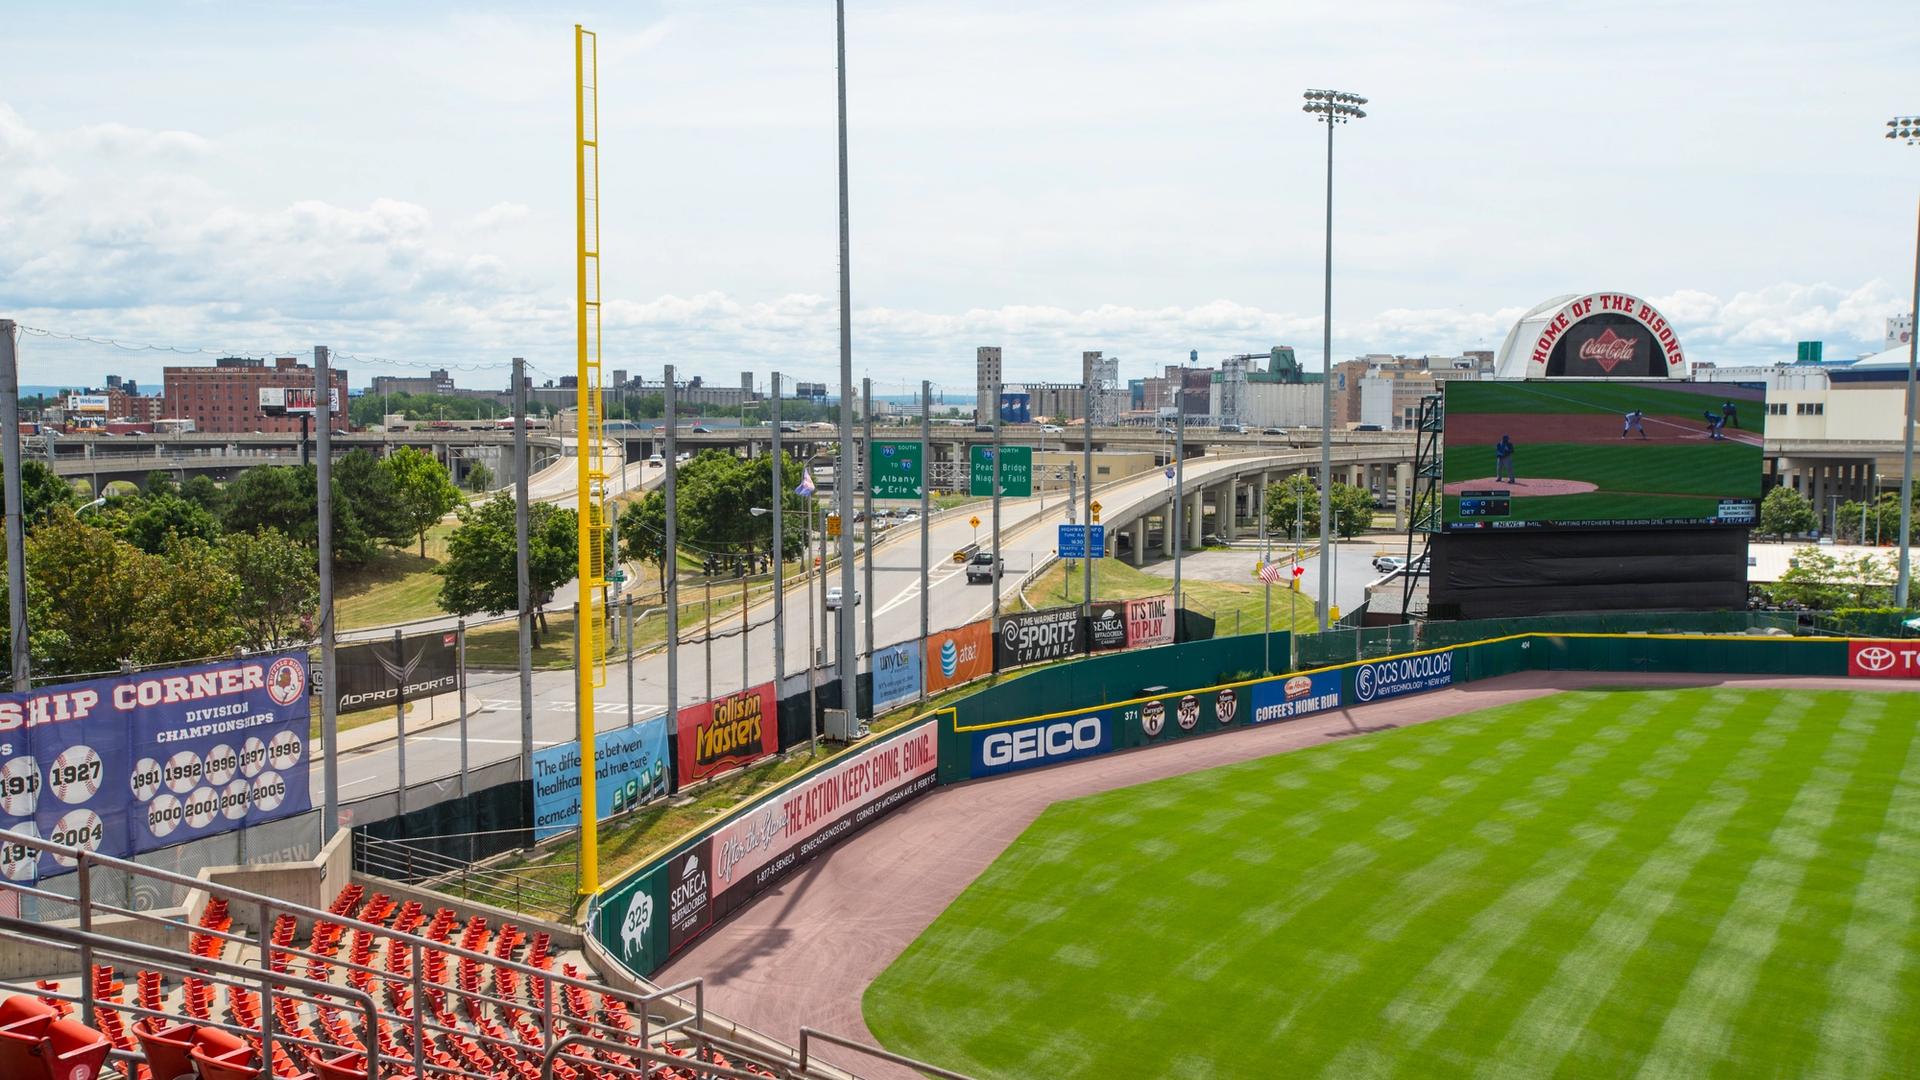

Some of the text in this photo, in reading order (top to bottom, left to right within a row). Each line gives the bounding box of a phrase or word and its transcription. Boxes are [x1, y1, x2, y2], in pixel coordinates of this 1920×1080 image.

[1533, 295, 1683, 365] HOME OF THE BISONS
[881, 475, 916, 484] Albany
[1002, 463, 1027, 473] Bridge
[1008, 474, 1026, 483] Falls
[1059, 611, 1076, 621] CABLE
[1131, 600, 1166, 621] IT'S TIME
[1019, 620, 1078, 649] SPORTS
[1093, 619, 1123, 631] SENECA
[1130, 619, 1163, 639] TO PLAY
[959, 641, 977, 663] at&t
[1017, 642, 1074, 662] CHANNEL
[1377, 651, 1453, 685] CCS ONCOLOGY
[113, 664, 264, 711] CORNER
[340, 675, 454, 712] ADPRO SPORTS
[1378, 687, 1390, 696] NEW
[1391, 682, 1423, 693] TECHNOLOGY
[1428, 678, 1440, 687] NEW
[186, 702, 249, 723] DIVISION
[714, 694, 761, 726] Collision
[1124, 710, 1138, 721] 371
[1182, 708, 1196, 726] 25
[1219, 701, 1234, 720] 30
[1255, 701, 1294, 722] COFFEE'S
[1295, 697, 1320, 715] HOME
[1320, 693, 1338, 710] RUN
[156, 713, 274, 743] CHAMPIONSHIPS
[1150, 714, 1158, 732] 6
[696, 714, 762, 761] Masters
[983, 717, 1101, 767] GEICO
[52, 760, 101, 786] 1927
[133, 742, 300, 789] 1991 1992 1996 1997 1998
[535, 760, 557, 777] The
[558, 750, 605, 772] diffece
[595, 761, 608, 780] nd
[610, 761, 628, 775] true
[614, 759, 662, 806] ECMC
[149, 806, 181, 825] 2000
[185, 799, 219, 818] 2001
[253, 783, 285, 800] 2005
[718, 833, 746, 884] After
[746, 820, 760, 853] the
[784, 797, 802, 838] THE
[805, 775, 840, 827] ACTION
[841, 758, 870, 806] KEEPS
[872, 745, 902, 791] GOING,
[904, 733, 936, 773] GOING...
[856, 805, 875, 822] CORNER
[882, 790, 904, 808] MICHIGAN
[52, 823, 102, 847] 2004
[671, 870, 707, 911] SENECA
[628, 901, 649, 932] 325
[681, 914, 698, 931] CASINO
